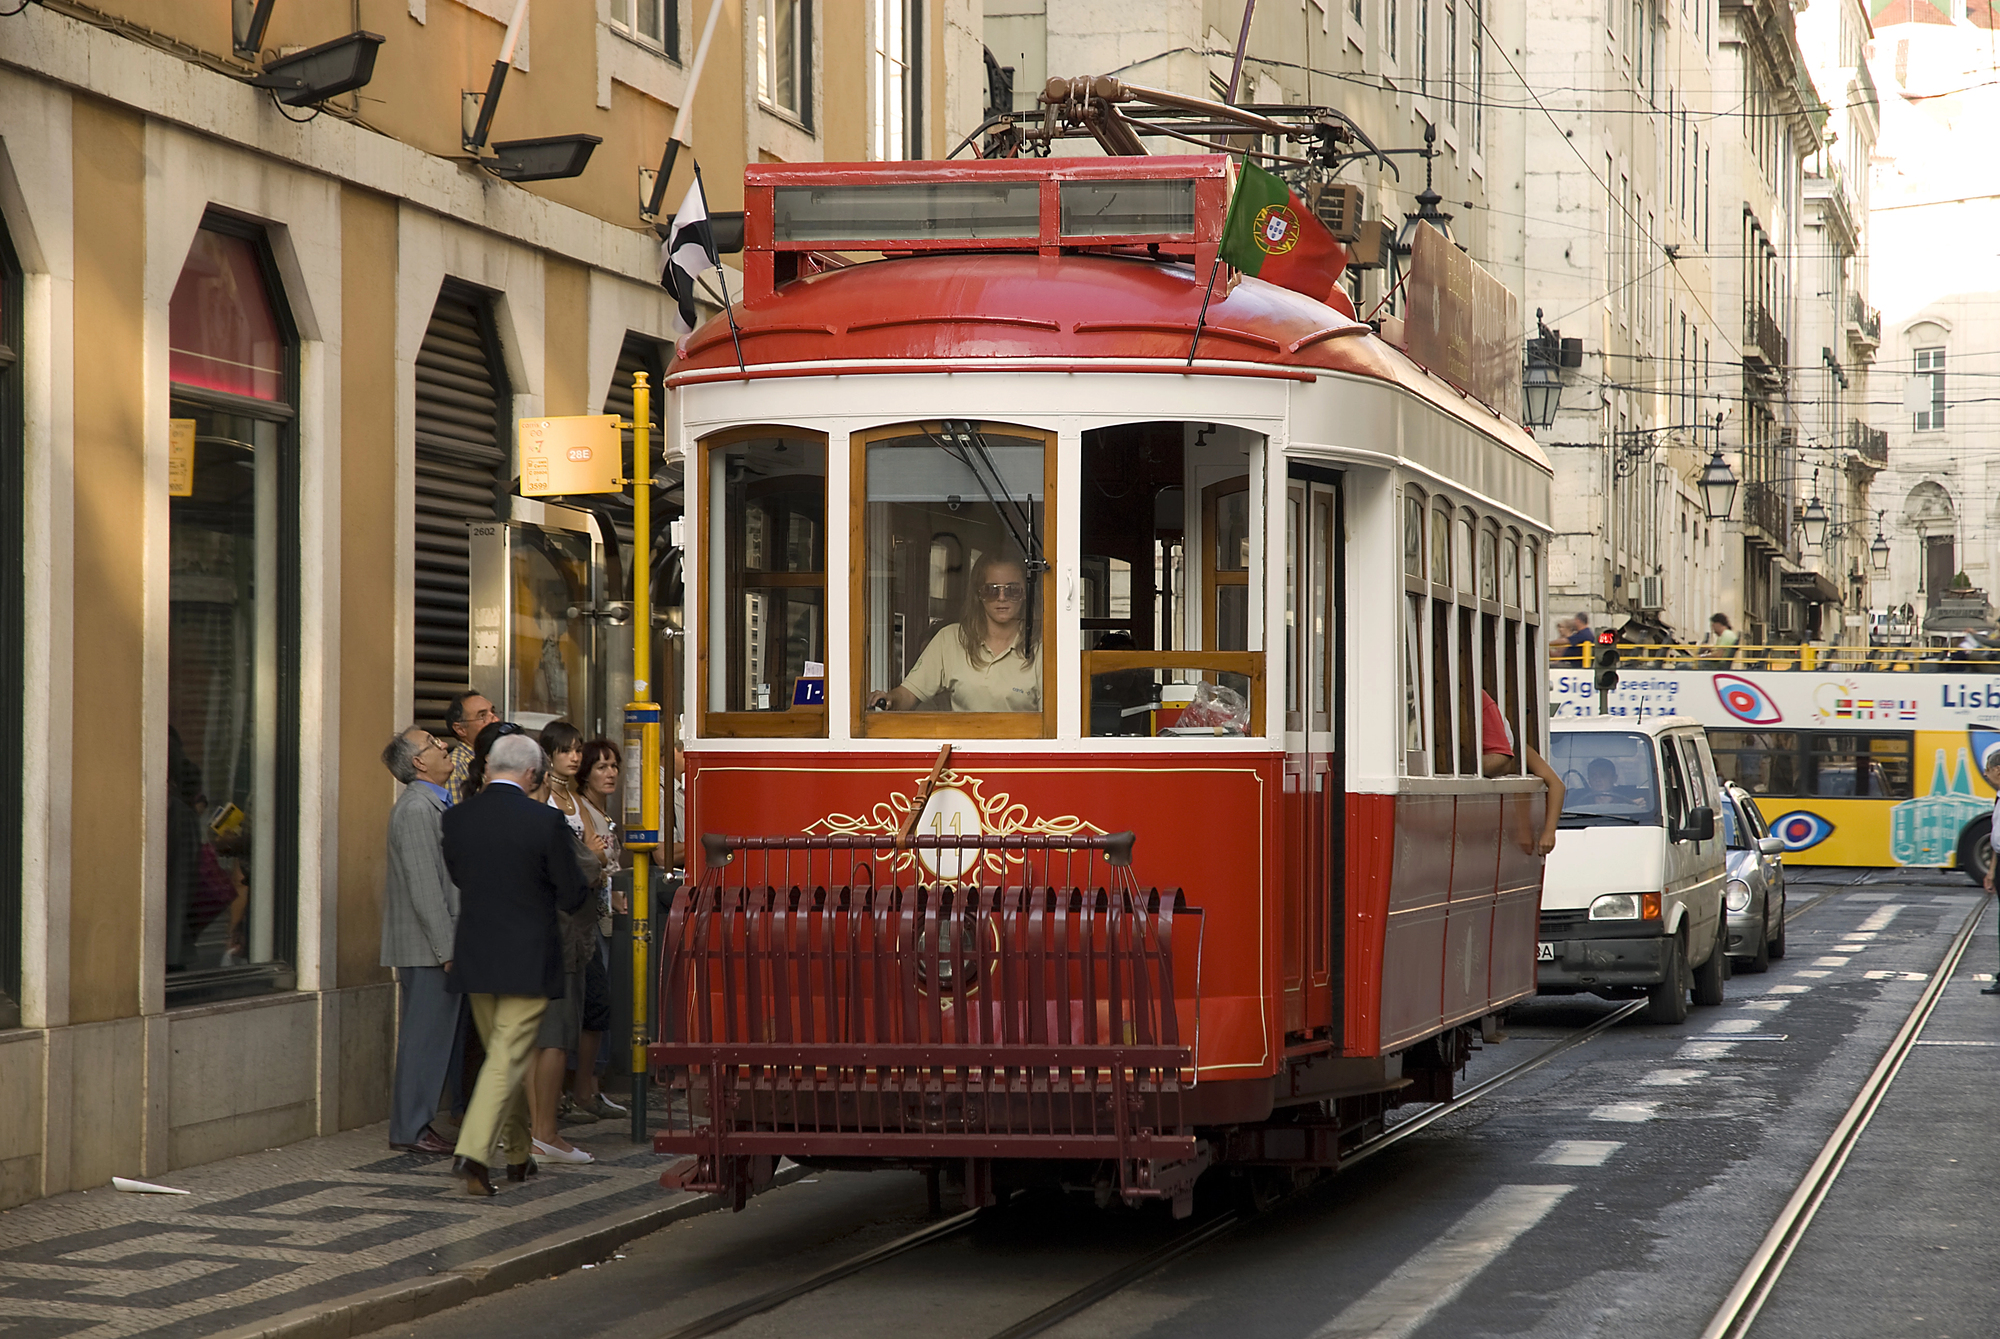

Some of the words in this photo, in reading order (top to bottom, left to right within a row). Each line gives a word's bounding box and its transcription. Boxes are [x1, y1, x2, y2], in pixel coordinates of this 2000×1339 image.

[569, 449, 590, 459] 28E
[473, 527, 495, 536] 2602
[1558, 676, 1679, 698] Sigseeing
[1574, 706, 1591, 716] 21
[930, 811, 961, 857] 11
